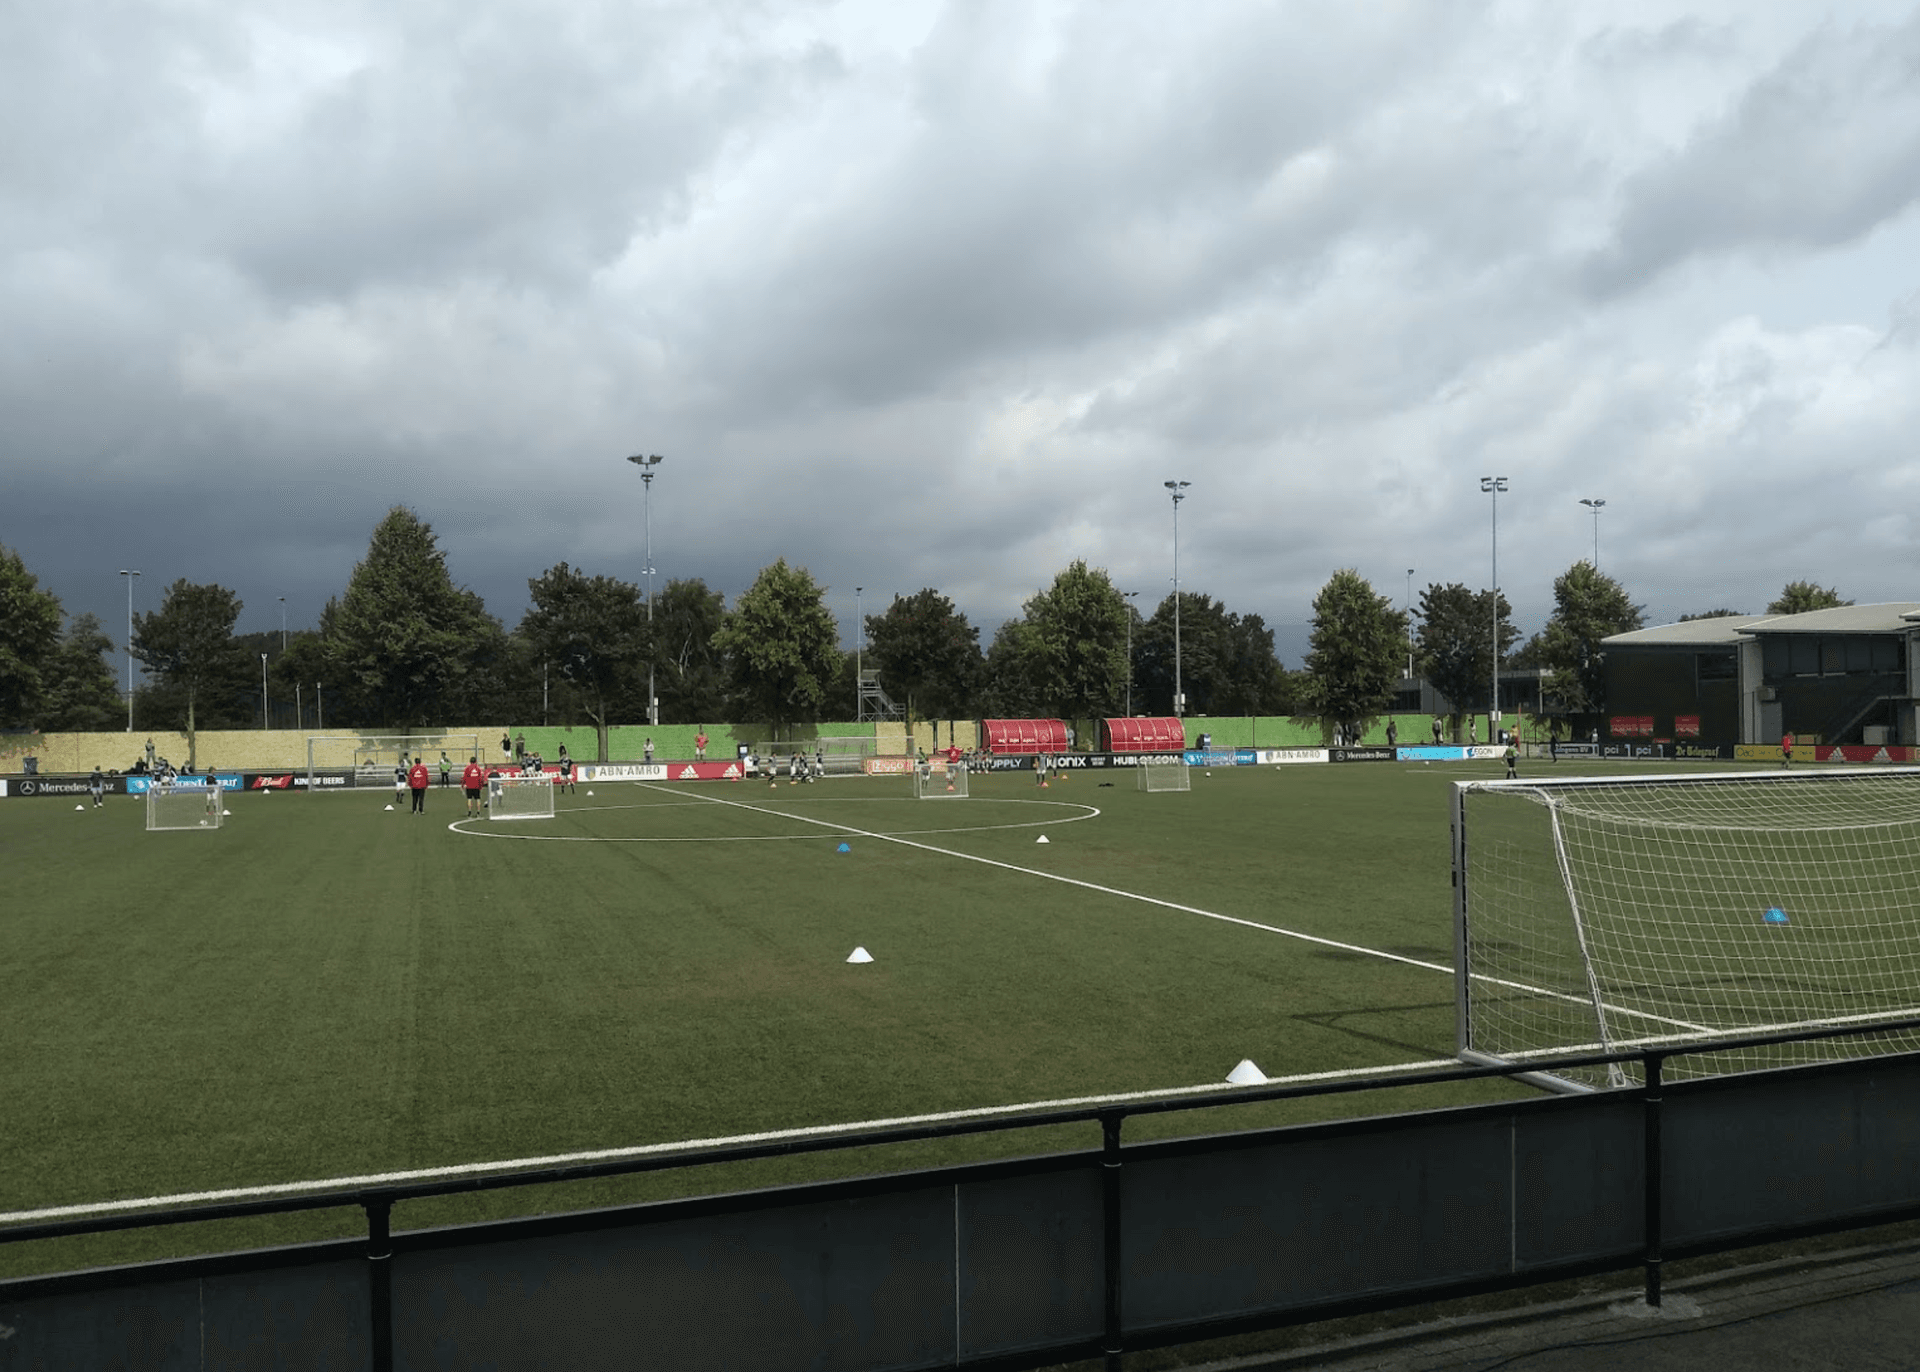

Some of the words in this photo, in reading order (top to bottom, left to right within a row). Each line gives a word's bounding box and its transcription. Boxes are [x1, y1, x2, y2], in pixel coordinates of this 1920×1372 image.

[1604, 744, 1619, 757] pci
[1636, 744, 1652, 757] pci
[1113, 755, 1179, 766] HUBLOT.COM
[38, 781, 115, 793] Mercedes-nz
